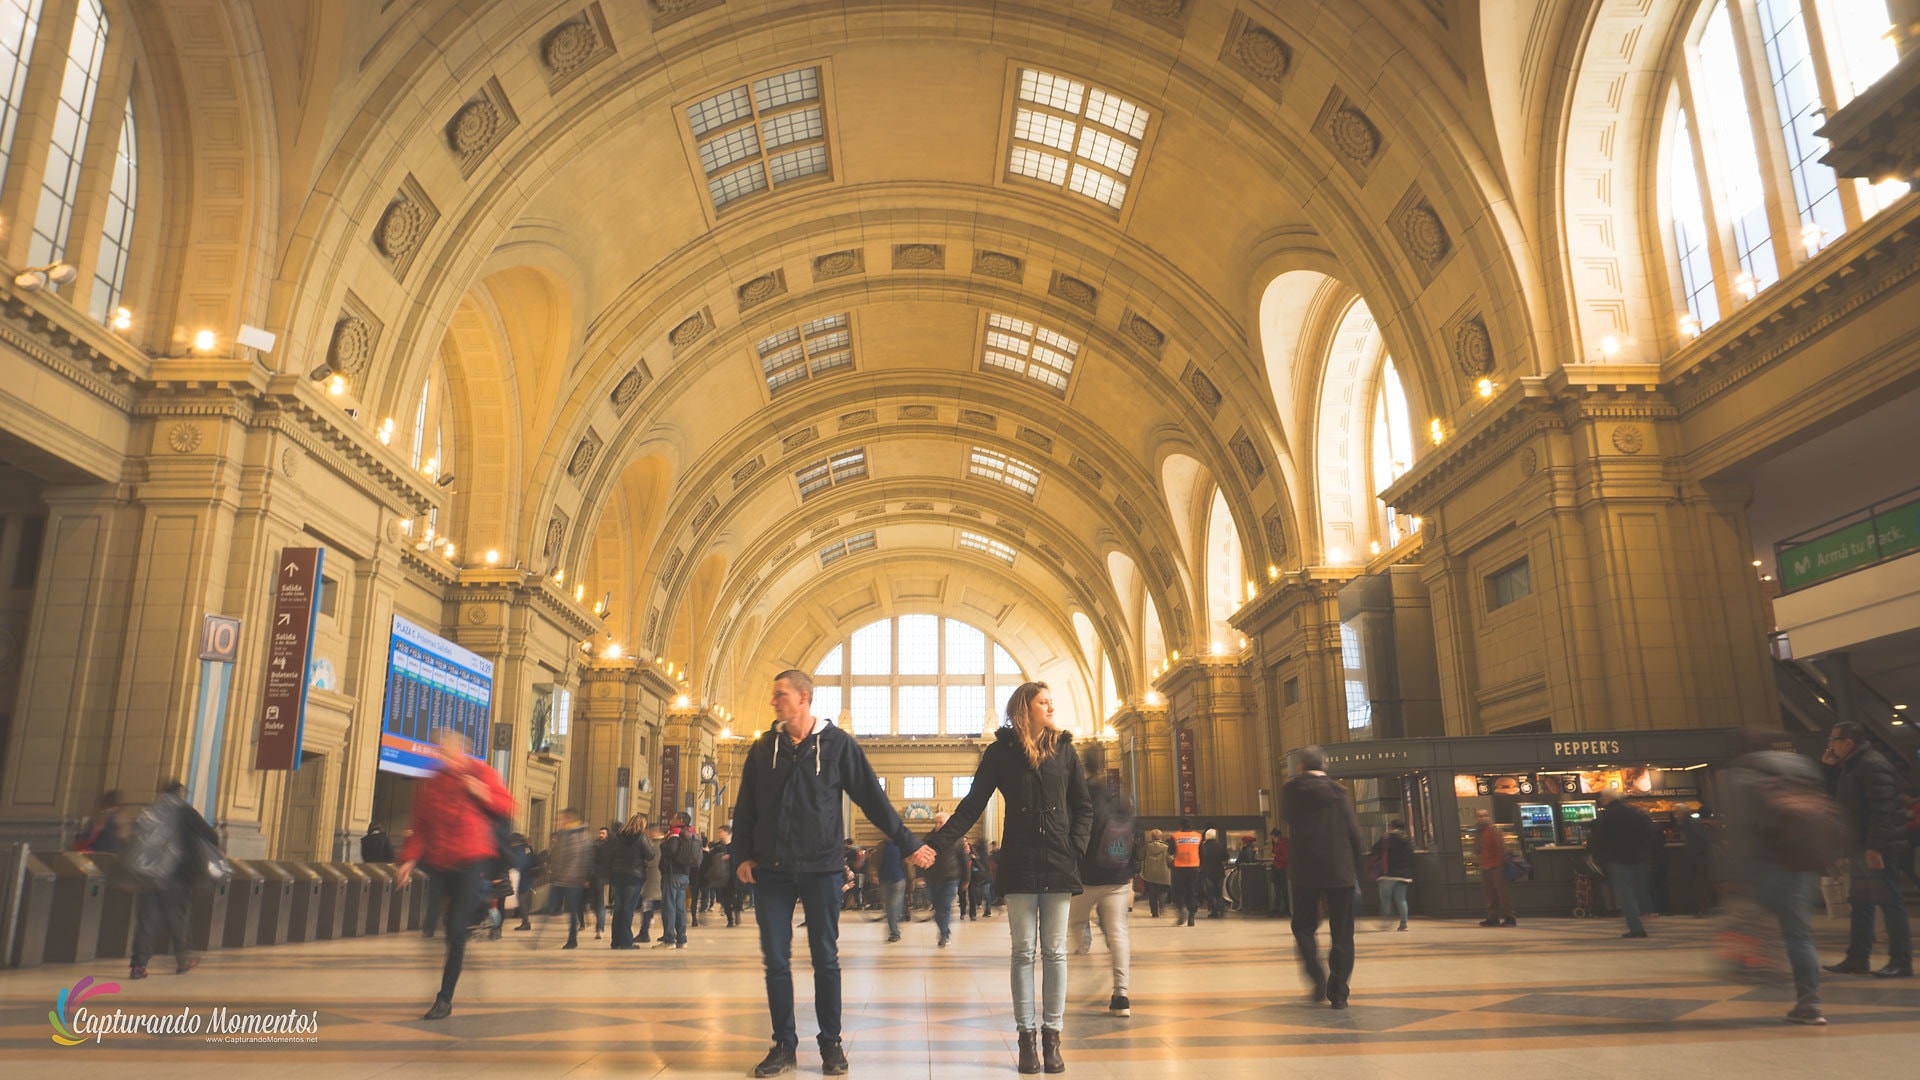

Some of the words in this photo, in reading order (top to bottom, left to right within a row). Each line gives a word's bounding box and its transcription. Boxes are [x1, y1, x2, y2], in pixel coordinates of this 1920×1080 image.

[1817, 544, 1848, 566] Armá
[1851, 543, 1865, 555] tu
[1866, 526, 1905, 549] Pack.
[396, 621, 412, 635] PLAZA
[206, 621, 235, 655] 10
[264, 722, 284, 730] Subte
[498, 727, 508, 744] 8
[1554, 739, 1620, 756] PEPPER'S
